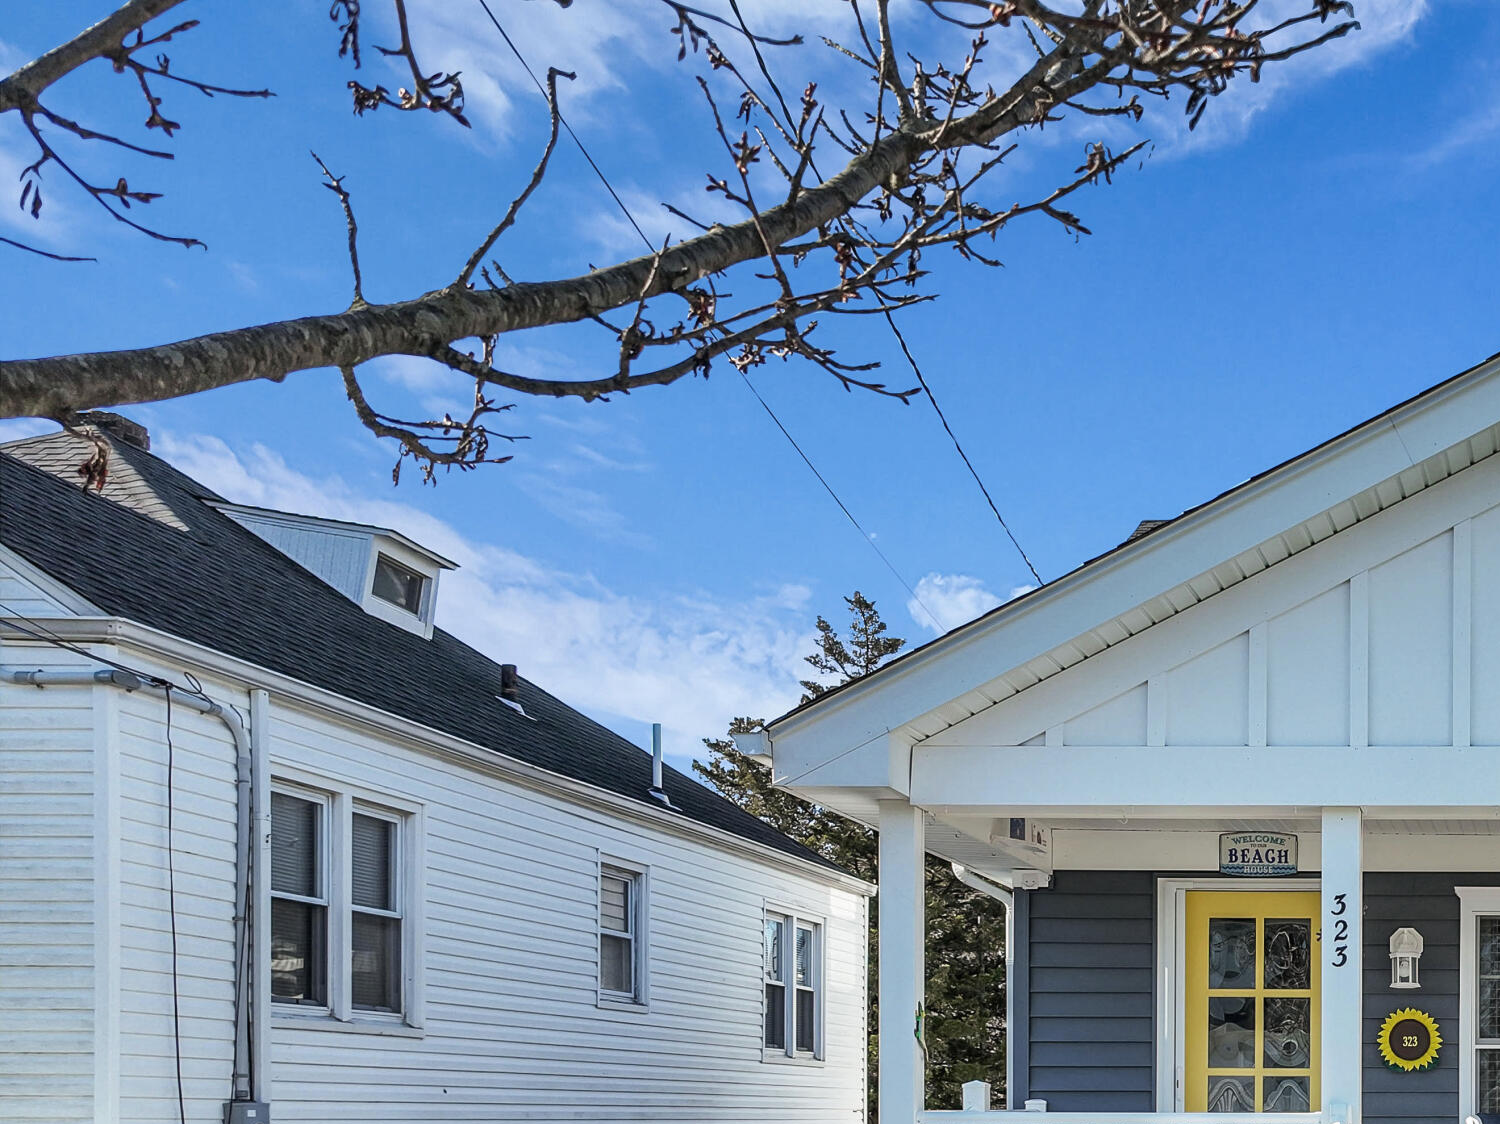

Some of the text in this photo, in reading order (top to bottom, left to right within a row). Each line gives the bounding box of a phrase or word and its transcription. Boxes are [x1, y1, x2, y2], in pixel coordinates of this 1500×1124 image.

[1231, 835, 1286, 846] WELCOME
[1228, 848, 1289, 863] BEACH
[1331, 893, 1348, 968] 323
[1402, 1035, 1418, 1047] 323
